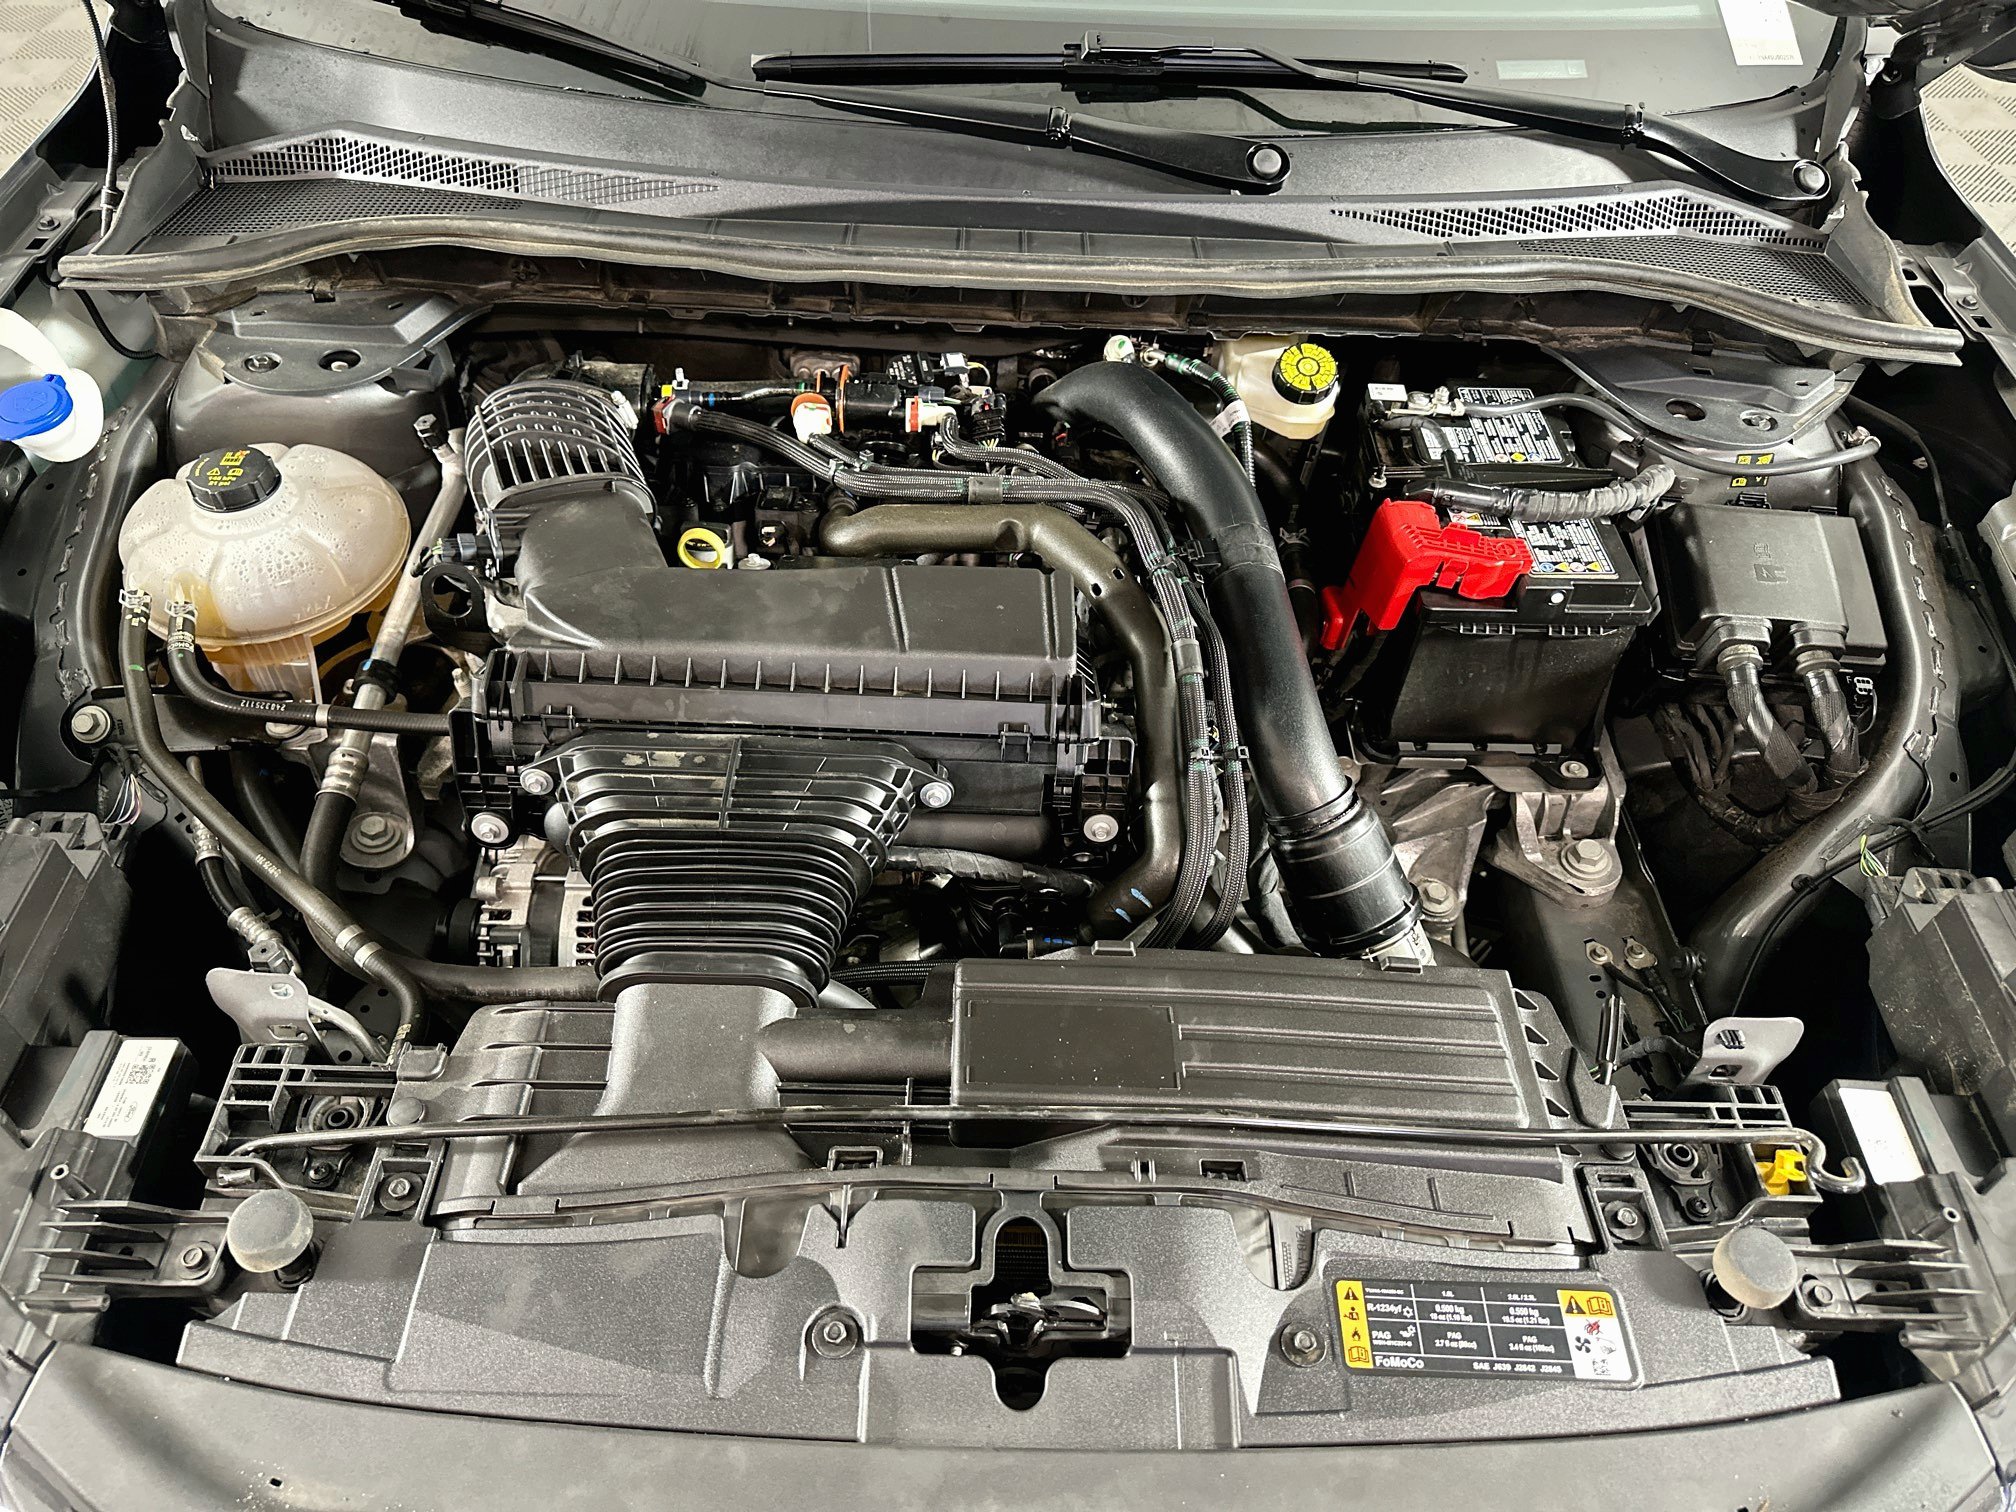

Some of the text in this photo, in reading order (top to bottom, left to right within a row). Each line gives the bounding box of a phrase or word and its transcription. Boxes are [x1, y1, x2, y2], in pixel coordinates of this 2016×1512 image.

[1367, 1303, 1402, 1314] R-1234yf
[1372, 1331, 1391, 1339] PAG
[1375, 1355, 1425, 1369] FoMoCo
[1473, 1362, 1490, 1370] SAE
